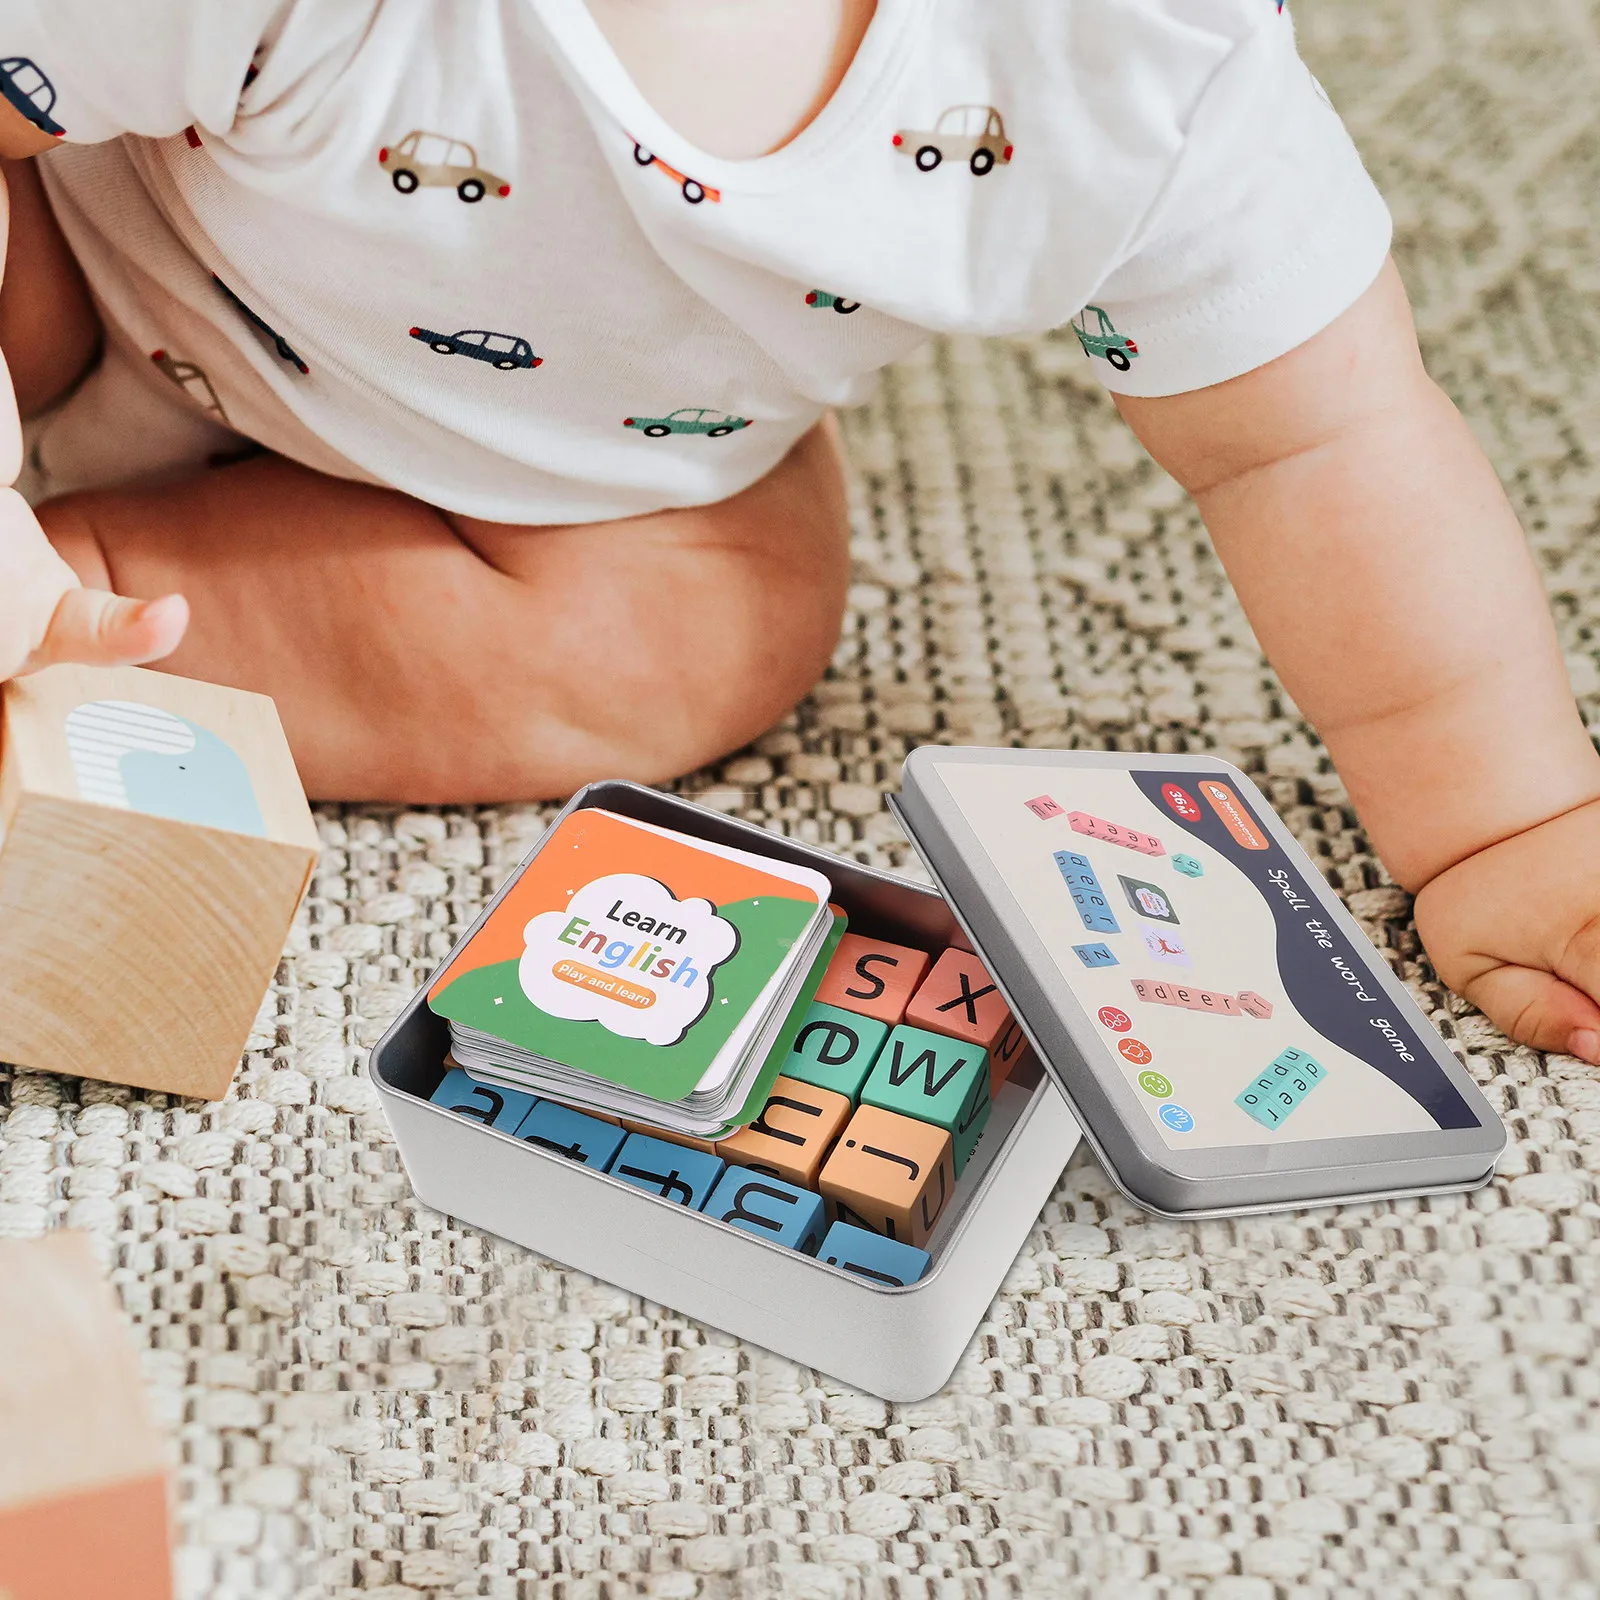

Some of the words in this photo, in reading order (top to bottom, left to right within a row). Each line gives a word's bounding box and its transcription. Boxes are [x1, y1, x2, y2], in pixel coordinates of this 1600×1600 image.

[606, 899, 687, 945] Learn
[557, 916, 699, 989] English
[1268, 868, 1311, 912] Spell
[1305, 918, 1333, 949] the
[1331, 956, 1377, 1003] word
[1369, 1018, 1415, 1063] game
[558, 963, 587, 984] Play
[588, 975, 615, 993] and
[618, 985, 651, 1006] learn
